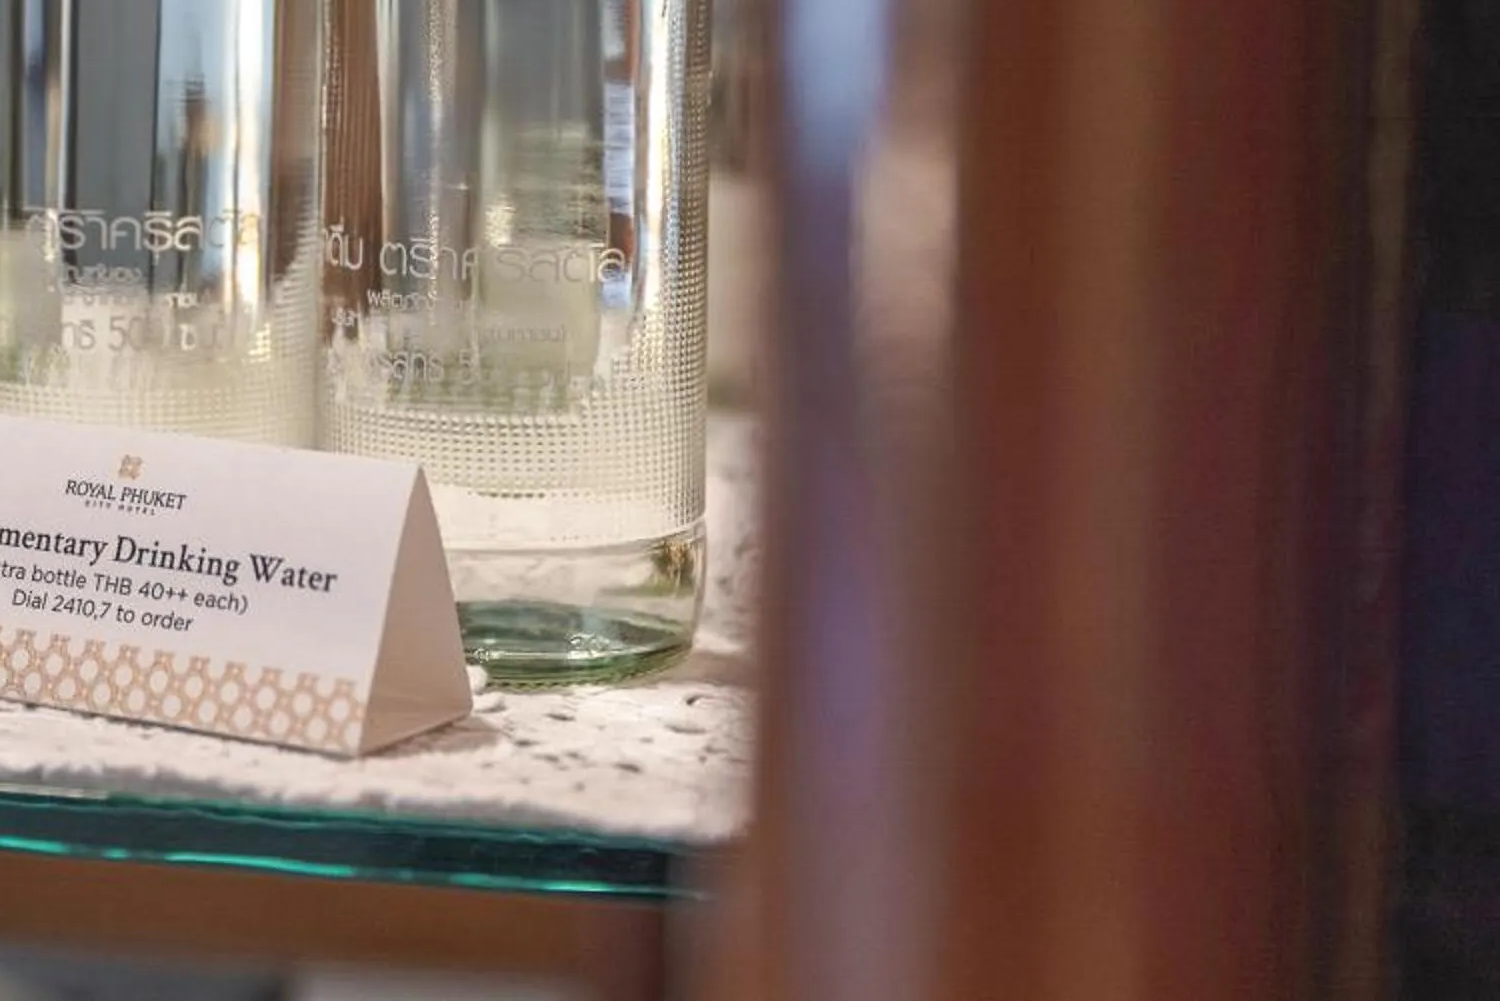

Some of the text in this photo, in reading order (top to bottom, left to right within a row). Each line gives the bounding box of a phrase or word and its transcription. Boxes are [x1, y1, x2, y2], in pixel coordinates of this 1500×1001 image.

[65, 479, 187, 510] ROYAL PHUKET
[113, 535, 241, 587] Drinking
[249, 553, 338, 593] Water
[12, 588, 48, 611] Dial
[116, 604, 135, 624] to
[141, 610, 194, 632] order
[31, 564, 87, 589] bottle
[93, 572, 133, 596] THB
[138, 580, 189, 600] 40++
[193, 590, 249, 616] each)
